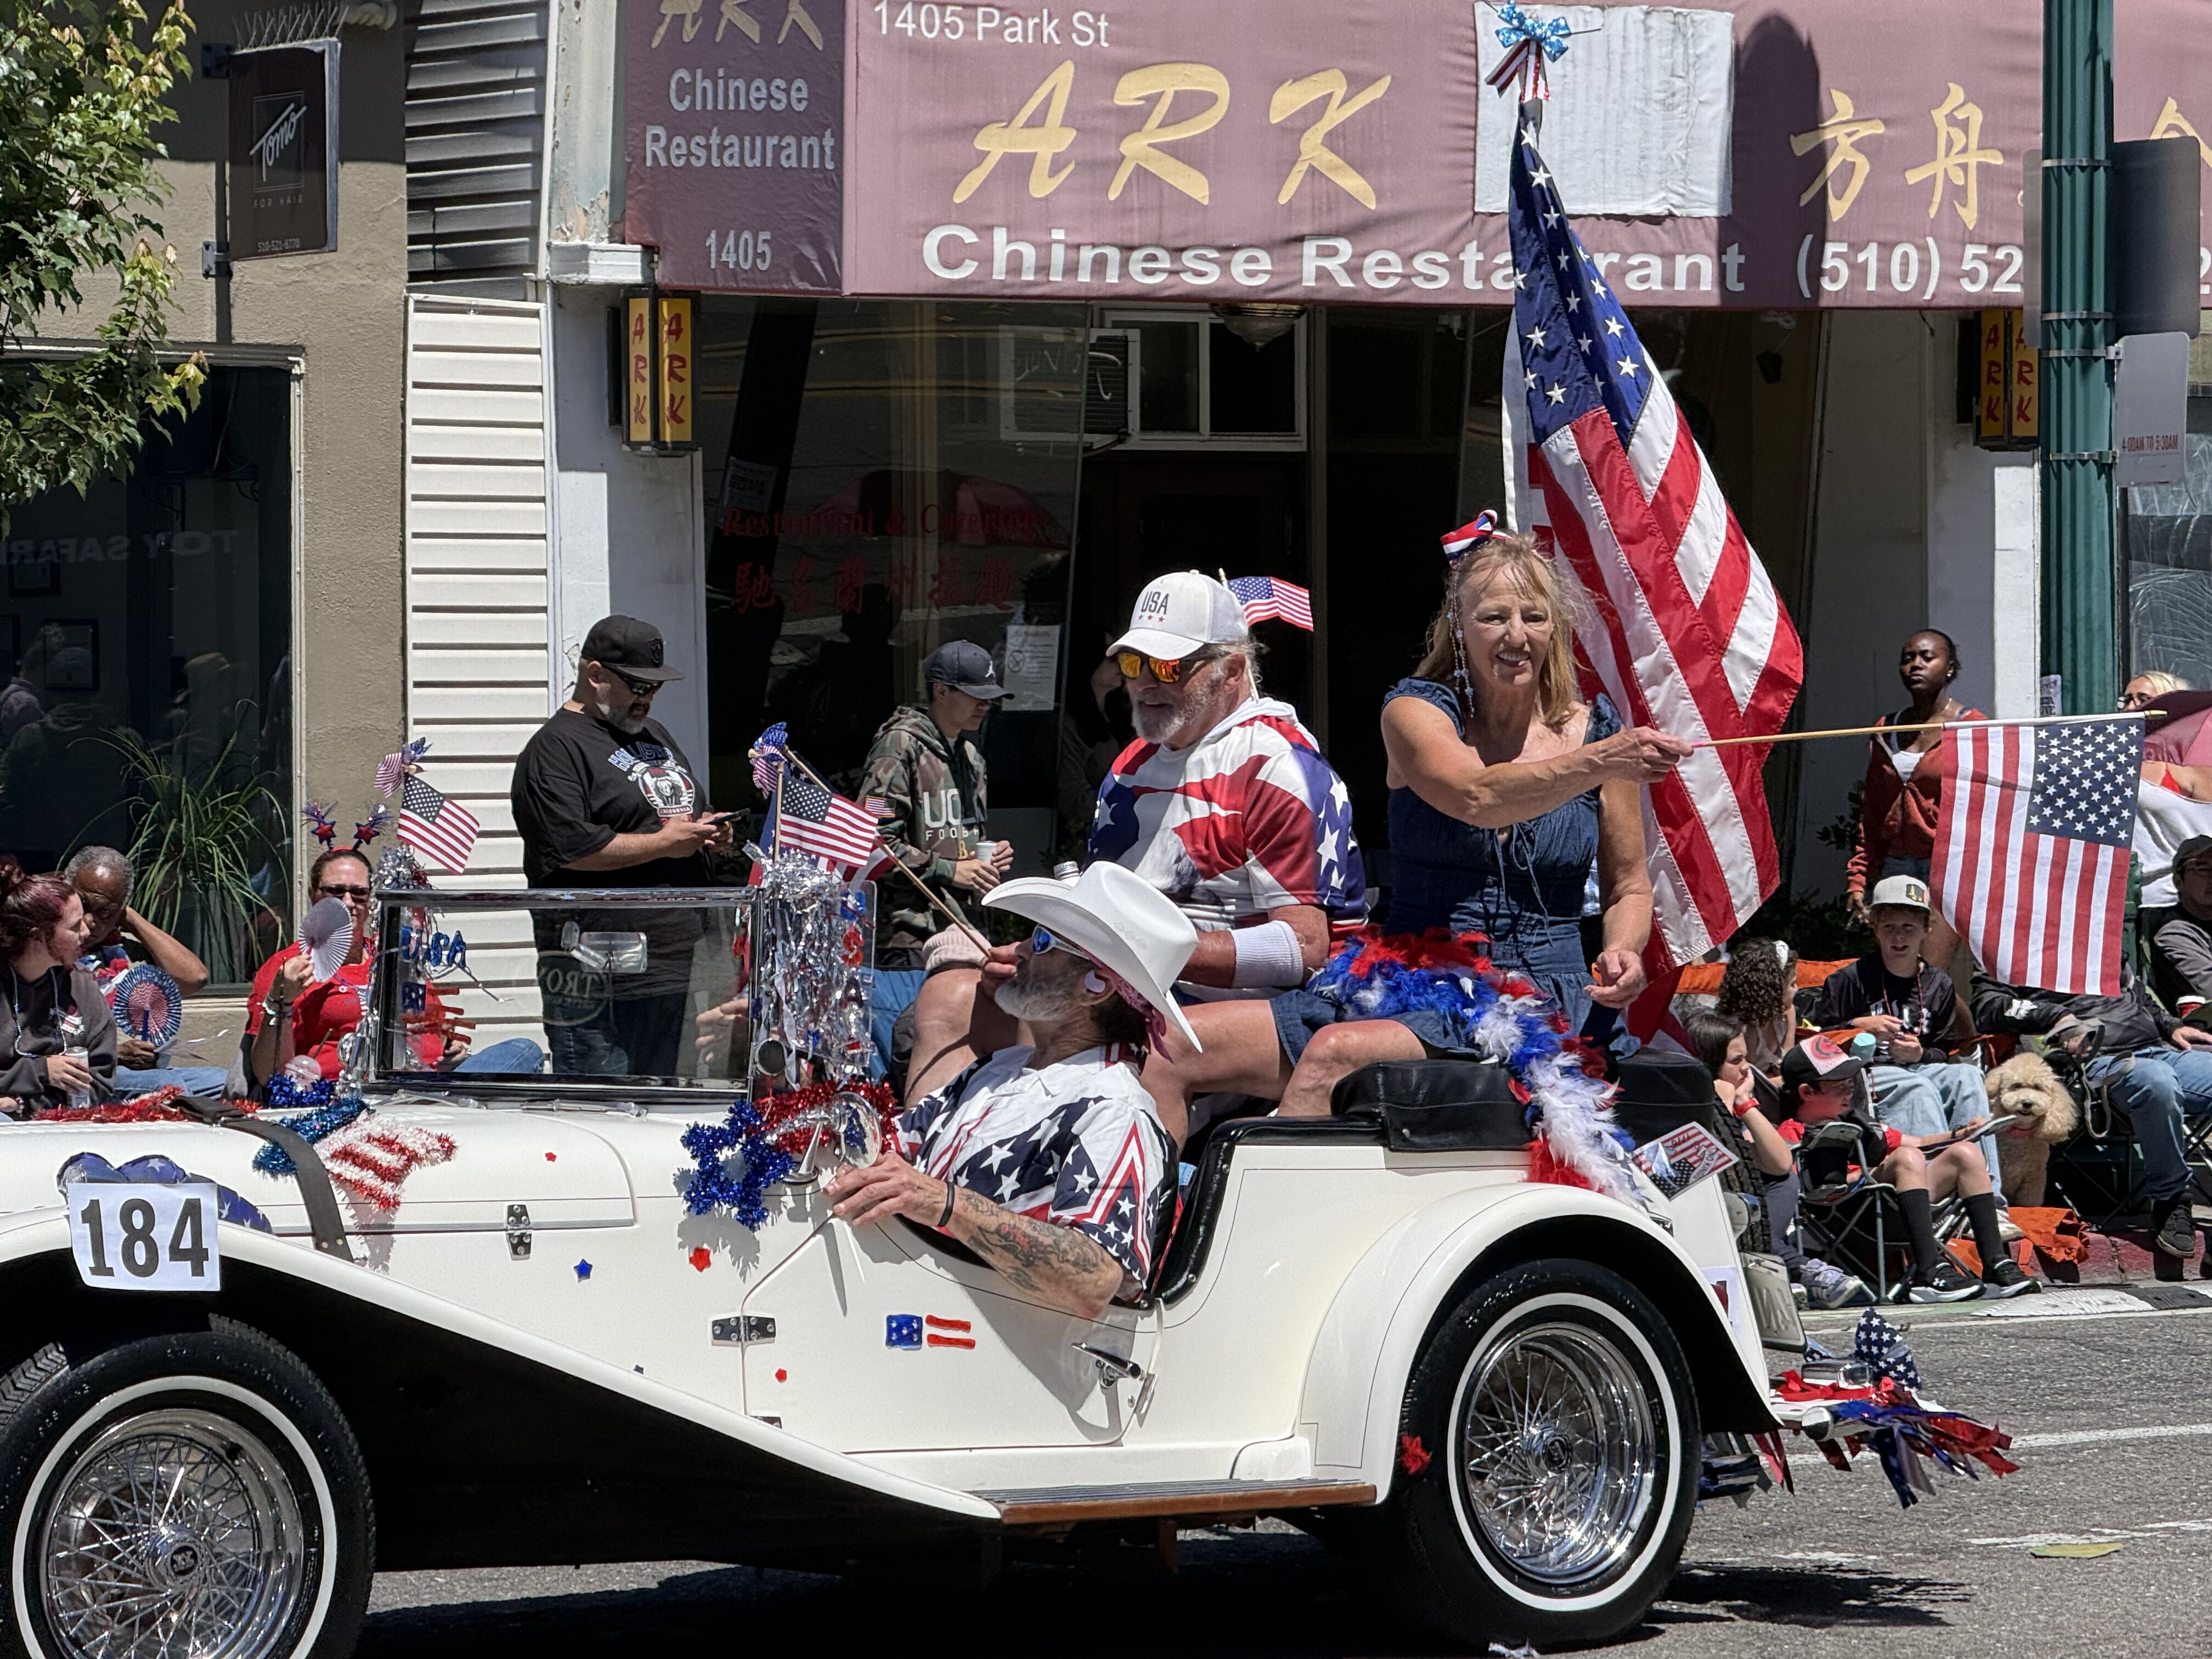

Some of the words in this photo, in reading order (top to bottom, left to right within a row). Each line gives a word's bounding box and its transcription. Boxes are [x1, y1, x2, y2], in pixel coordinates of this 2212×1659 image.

[874, 2, 966, 41] 1405
[977, 10, 1061, 45] Park
[1071, 10, 1110, 48] St
[669, 68, 809, 111] Chinese
[249, 103, 307, 182] Tomo
[645, 125, 834, 170] Restaurant
[951, 59, 1392, 210] ARK
[254, 198, 272, 208] FOR
[279, 195, 302, 205] HAIR
[258, 238, 300, 252] 510-521-8770
[705, 229, 772, 270] 1405
[923, 224, 1272, 286] Chinese
[1301, 235, 1745, 291] Restarant
[1797, 234, 1940, 300] (510)
[1960, 243, 2023, 294] 52
[633, 313, 647, 424] ARK
[664, 313, 686, 424] ARK
[1985, 324, 2002, 422] ARK
[2146, 436, 2154, 449] TO
[1142, 591, 1169, 615] USA
[81, 1198, 209, 1277] 184
